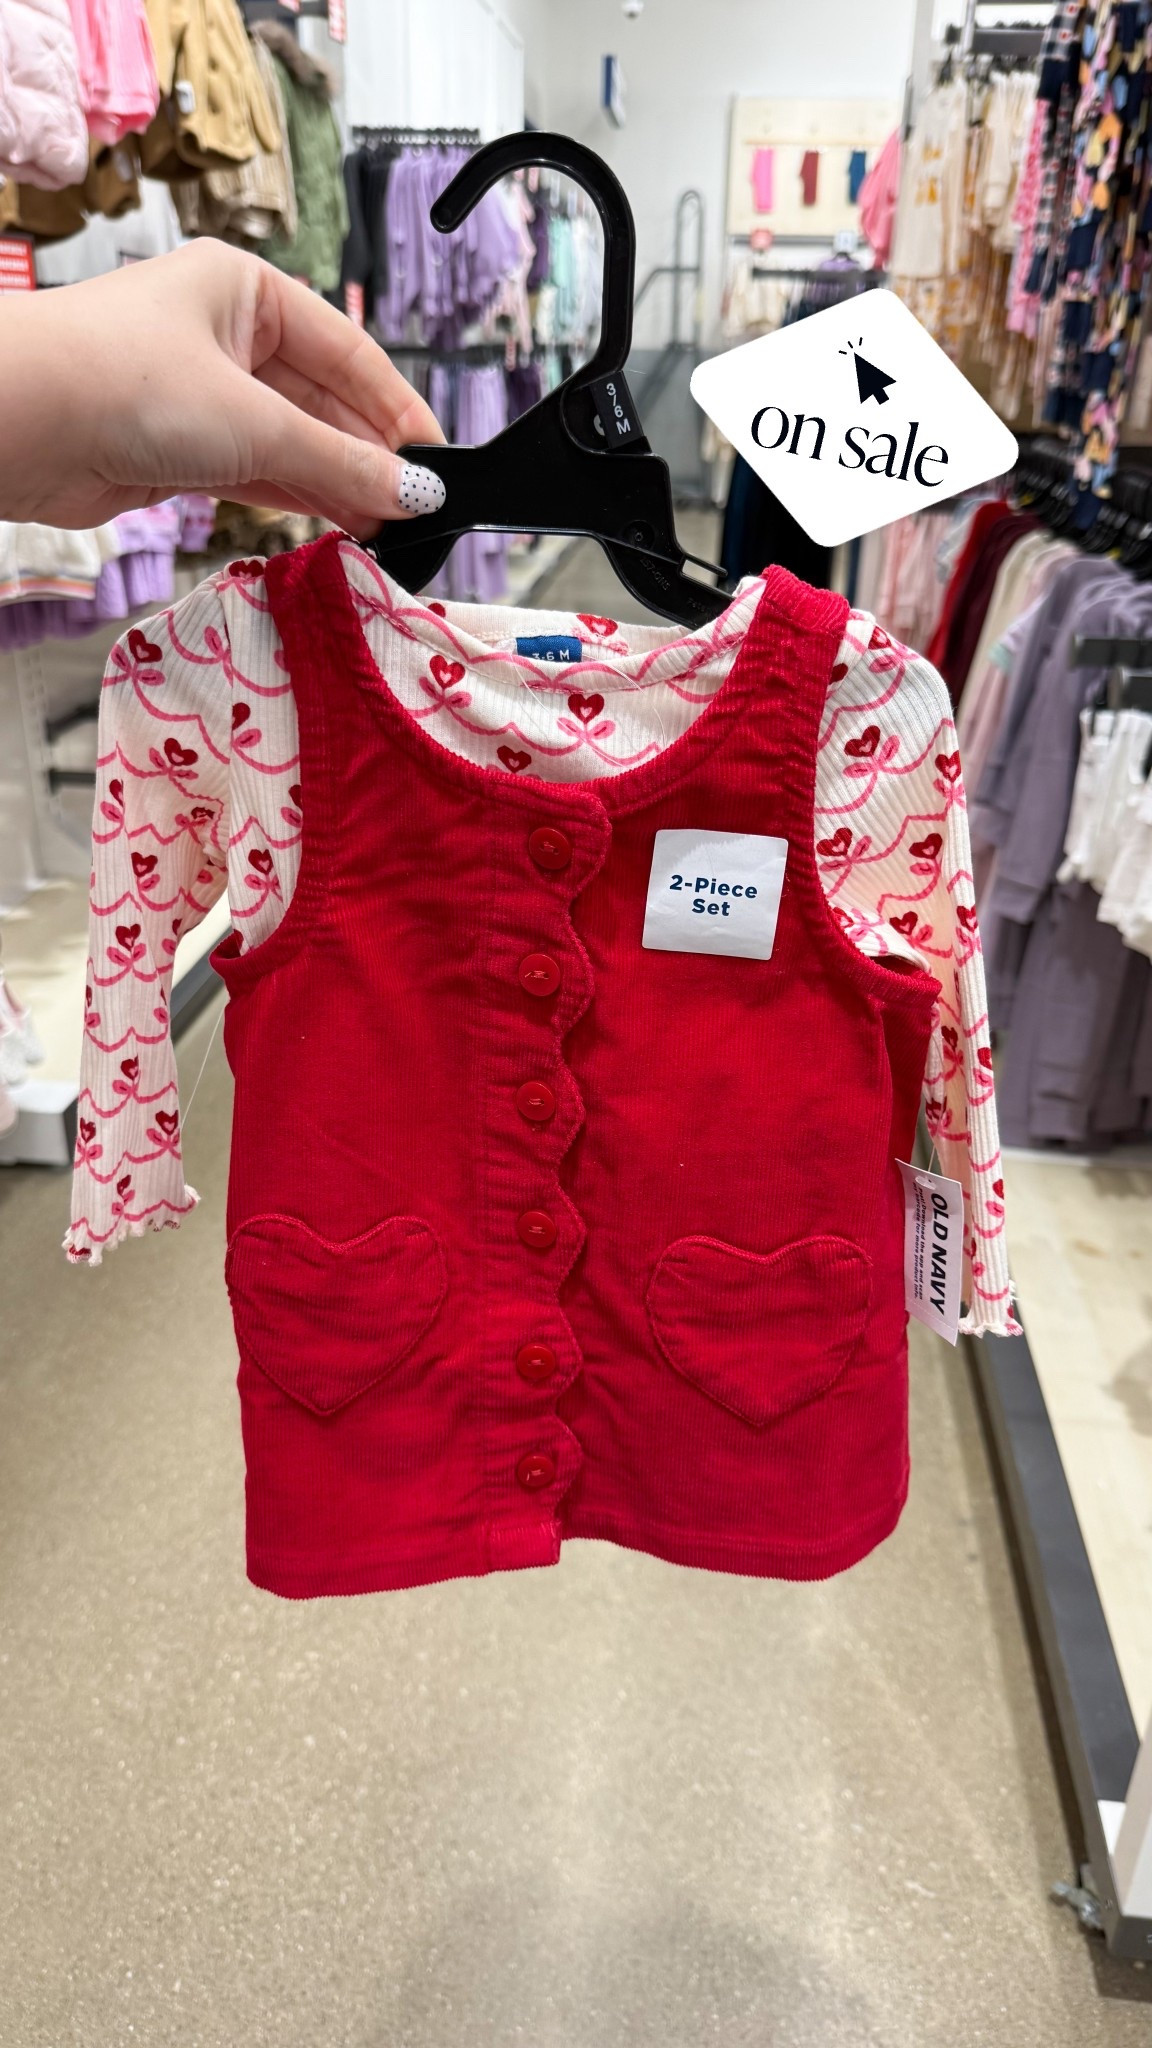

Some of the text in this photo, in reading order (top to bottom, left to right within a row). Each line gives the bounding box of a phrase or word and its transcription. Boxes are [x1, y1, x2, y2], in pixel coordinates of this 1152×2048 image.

[559, 649, 570, 661] M
[669, 874, 758, 898] 2-Piece
[692, 898, 731, 916] Set
[919, 1204, 927, 1239] Download
[930, 1193, 949, 1316] OLD NAVY
